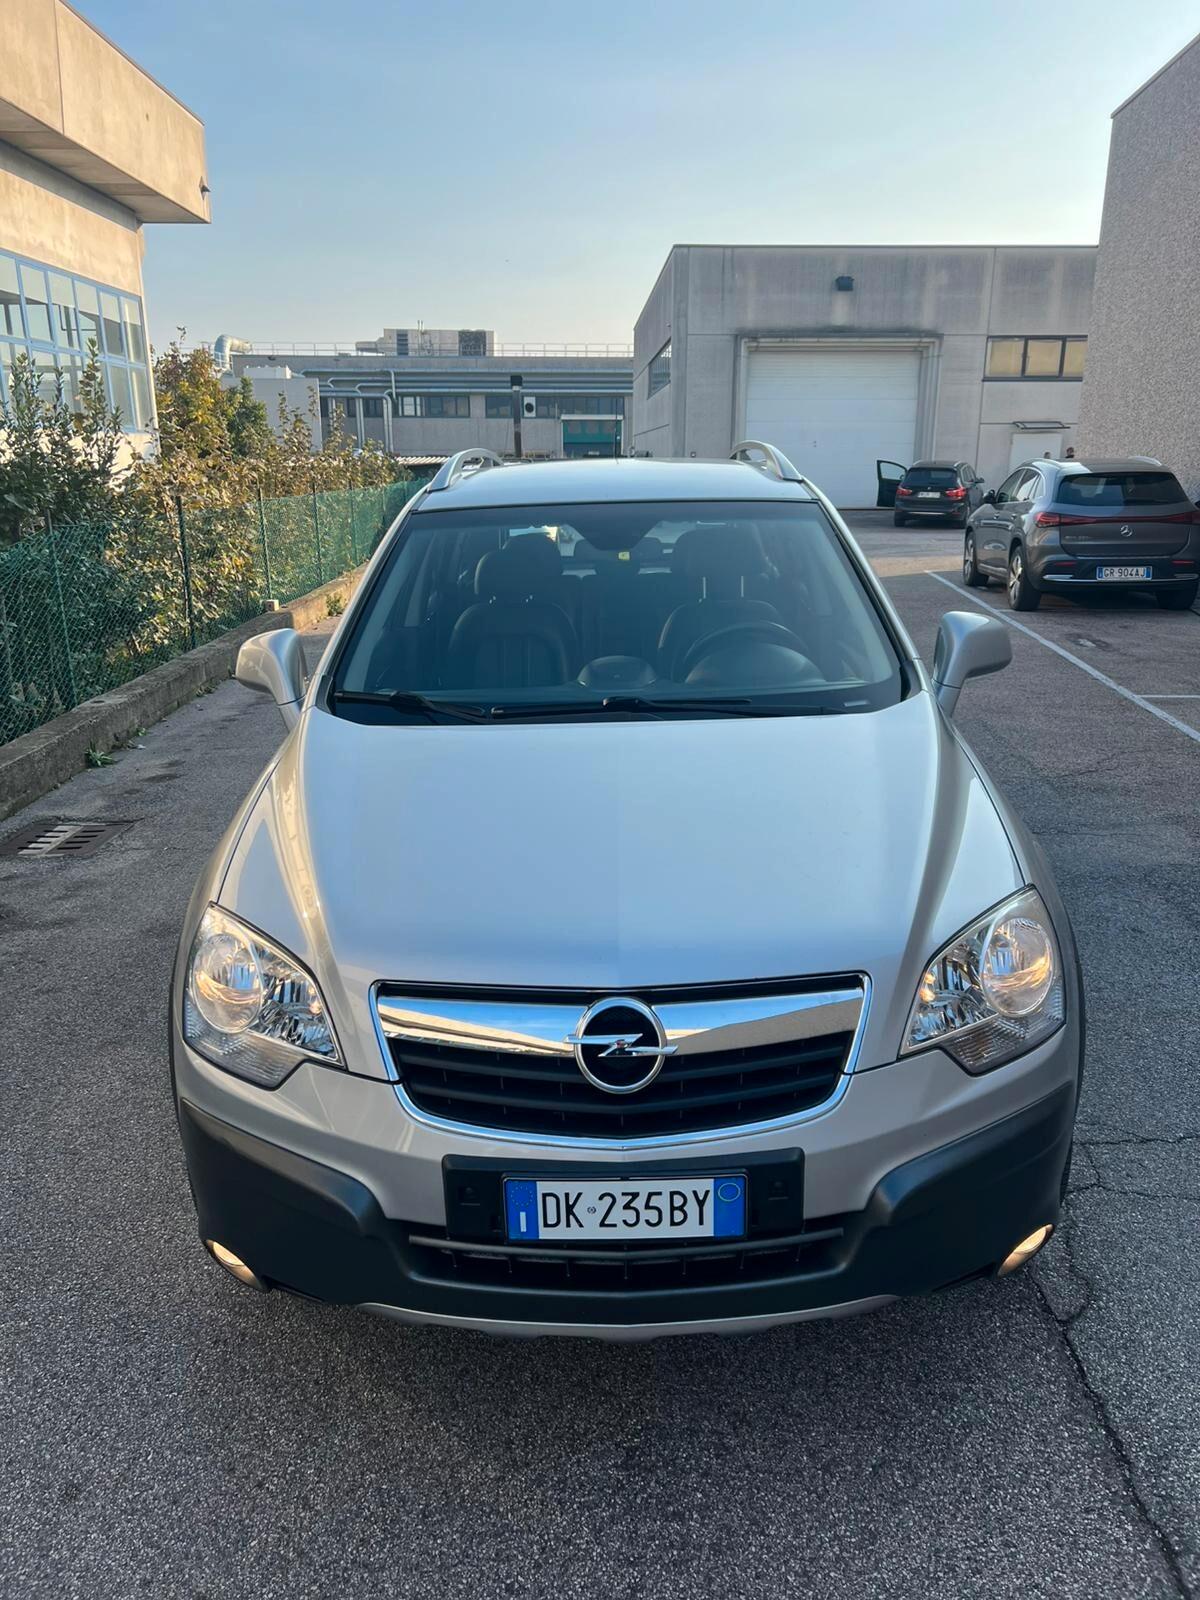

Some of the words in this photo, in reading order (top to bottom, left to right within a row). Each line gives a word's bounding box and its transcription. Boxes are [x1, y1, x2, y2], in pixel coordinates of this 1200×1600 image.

[1104, 568, 1115, 577] GR
[541, 1191, 584, 1229] DK
[598, 1189, 711, 1228] 235BY
